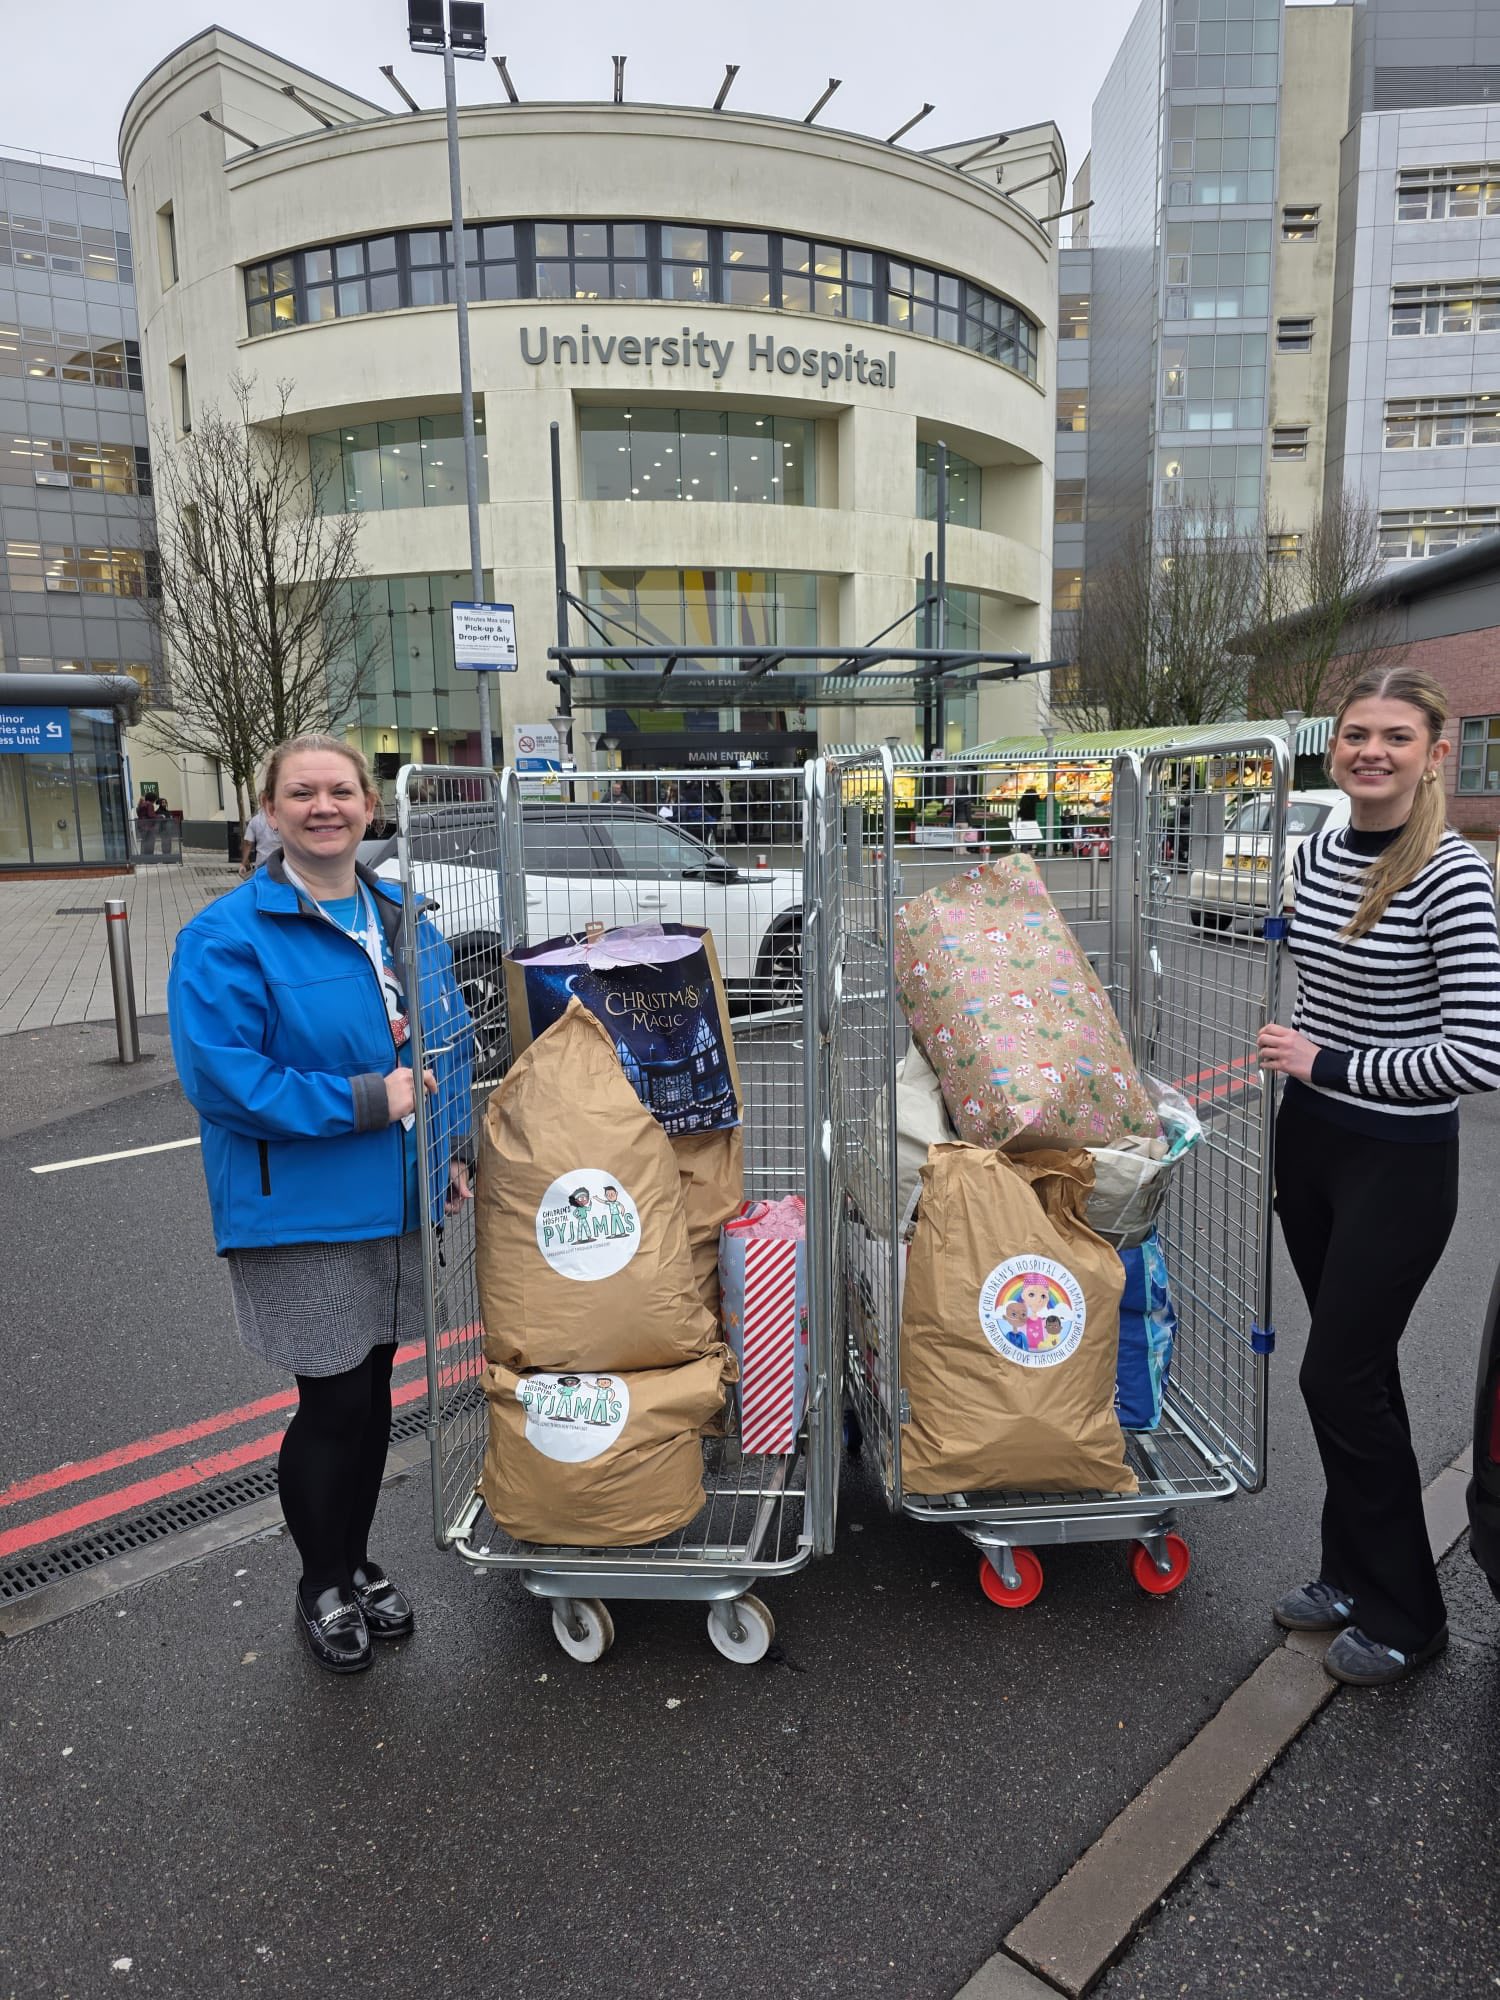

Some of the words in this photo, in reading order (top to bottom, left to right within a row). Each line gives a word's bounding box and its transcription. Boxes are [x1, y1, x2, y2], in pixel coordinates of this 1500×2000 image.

[519, 324, 735, 378] University
[748, 333, 896, 388] Hospital
[464, 615, 486, 623] Minutes
[465, 624, 494, 633] Pick-up
[496, 625, 503, 633] &
[458, 633, 490, 642] Drop-off
[492, 634, 511, 643] Only
[0, 714, 24, 723] inor
[20, 724, 40, 734] and
[16, 735, 40, 745] Unit
[688, 752, 717, 761] MAIN
[720, 751, 769, 760] ENTRANCE
[605, 985, 700, 1016] CHRISTMAS
[631, 1011, 688, 1032] MAGIC
[542, 1215, 569, 1226] HOSPITAL
[543, 1212, 635, 1247] PYJAMAS
[982, 1265, 1014, 1312] CHILDREN'S
[1016, 1259, 1057, 1277] HOSPITAL
[1058, 1272, 1084, 1312] PYJAMAS
[984, 1321, 1012, 1353] SPREADING
[1011, 1349, 1030, 1364] LOVE
[1034, 1350, 1066, 1365] THROUGH
[1064, 1321, 1083, 1355] COMFORT
[522, 1391, 623, 1423] PYJAMAS
